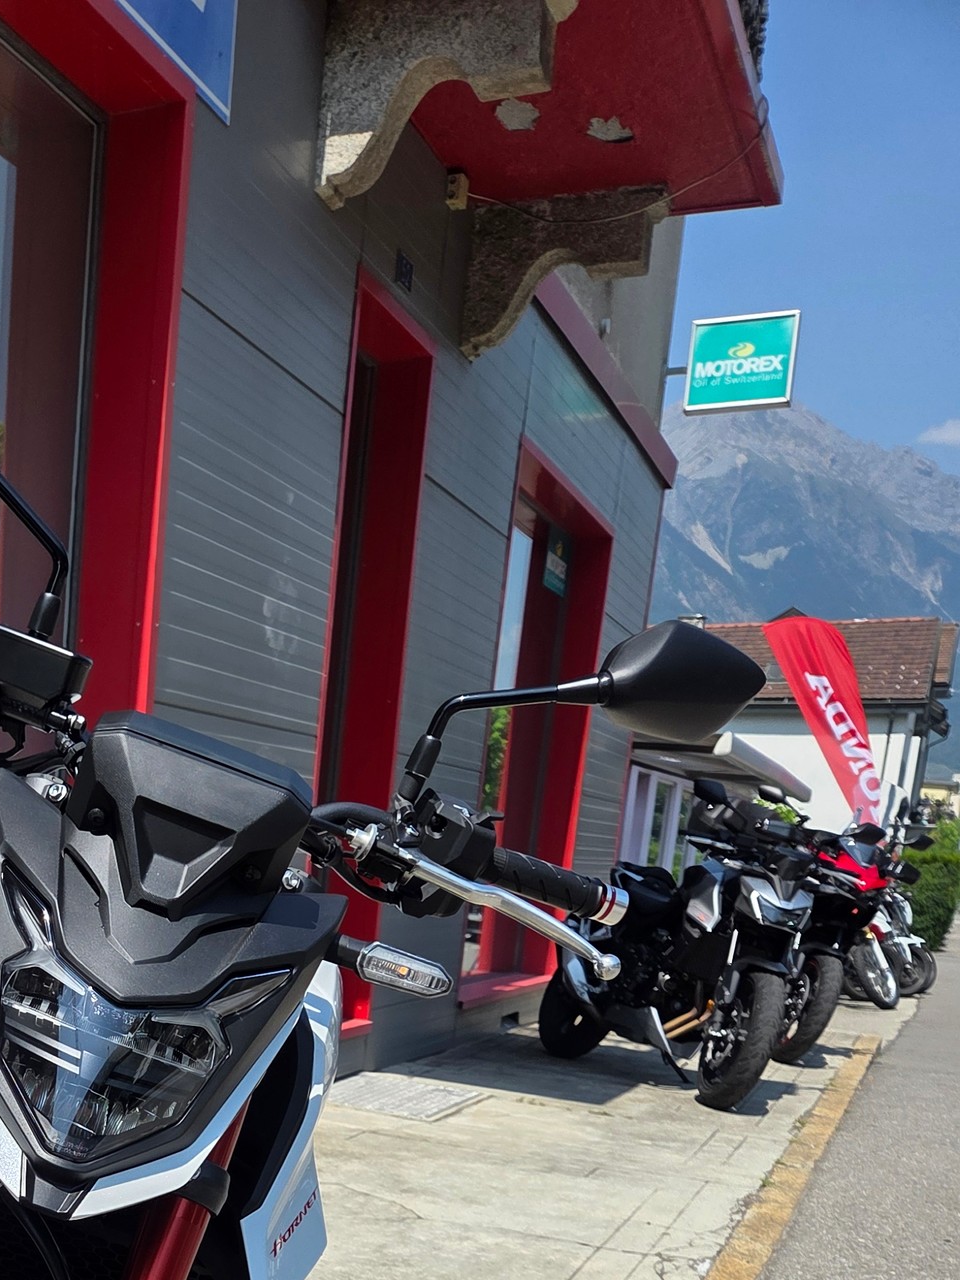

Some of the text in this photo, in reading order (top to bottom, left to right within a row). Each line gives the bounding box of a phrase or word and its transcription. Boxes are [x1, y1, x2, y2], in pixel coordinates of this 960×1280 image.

[694, 354, 785, 379] MOTOREX
[693, 372, 783, 388] Oil of Switzerland
[269, 1186, 319, 1258] HORNET
